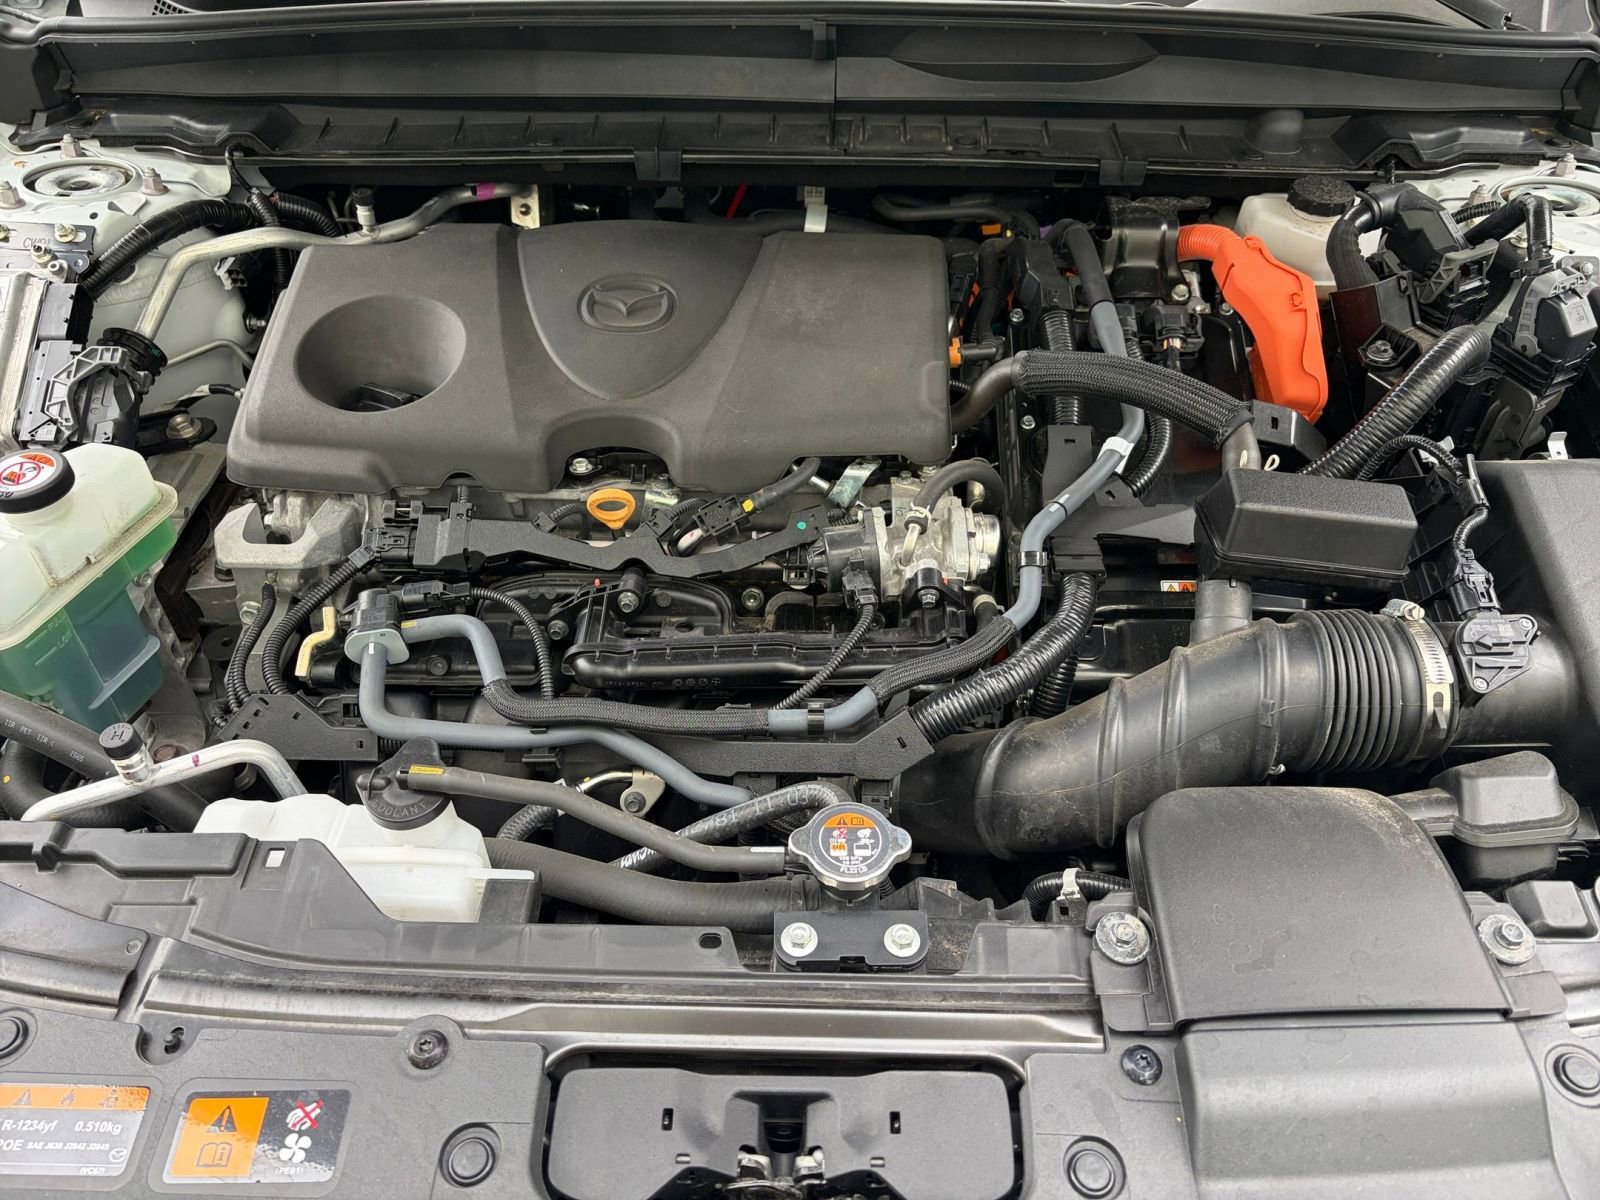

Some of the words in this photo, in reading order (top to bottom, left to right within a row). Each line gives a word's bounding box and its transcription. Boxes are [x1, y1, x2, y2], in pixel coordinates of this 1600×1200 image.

[20, 725, 32, 736] PET
[372, 799, 428, 818] COOLANT
[1, 1119, 59, 1134] R-1234yf
[74, 1120, 123, 1136] 0.510kg
